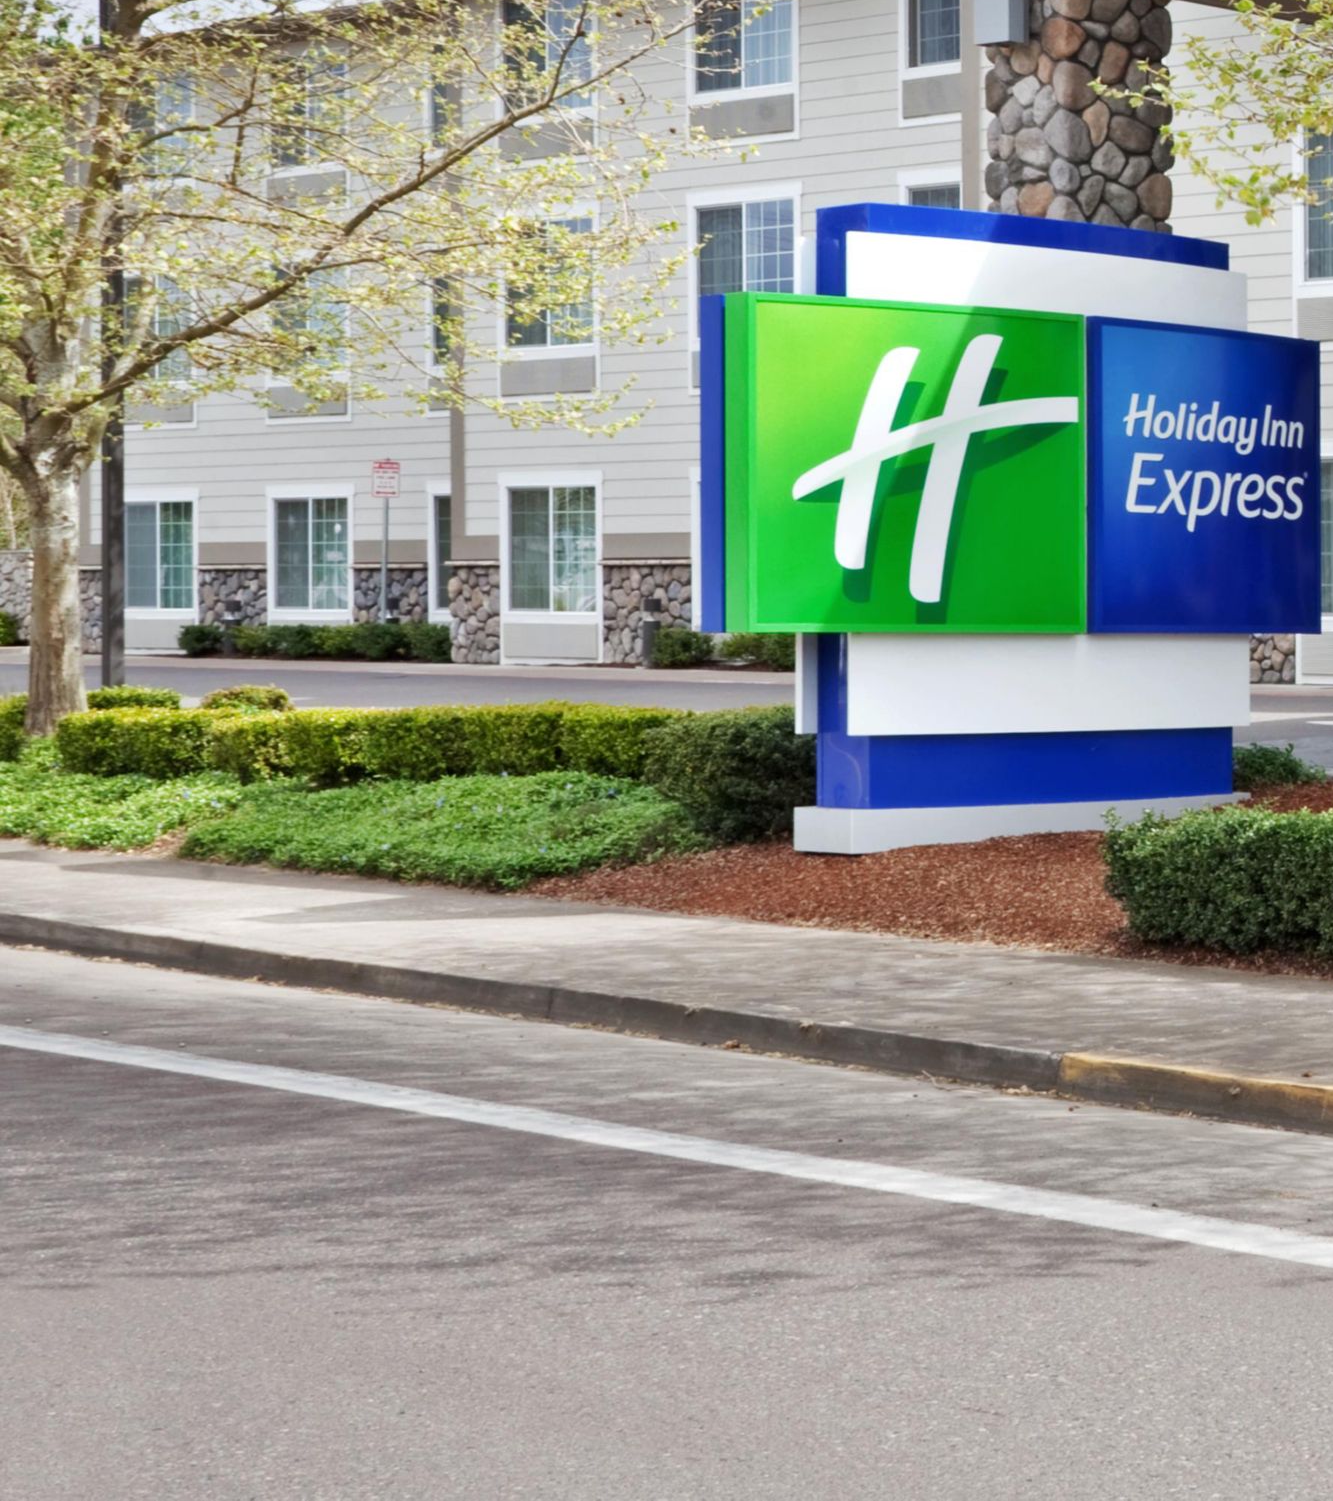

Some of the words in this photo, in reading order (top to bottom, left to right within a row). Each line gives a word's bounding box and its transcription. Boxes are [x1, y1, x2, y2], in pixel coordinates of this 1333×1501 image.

[1123, 392, 1258, 455] Holiday
[1261, 404, 1305, 449] Inn
[1125, 452, 1305, 533] Express
